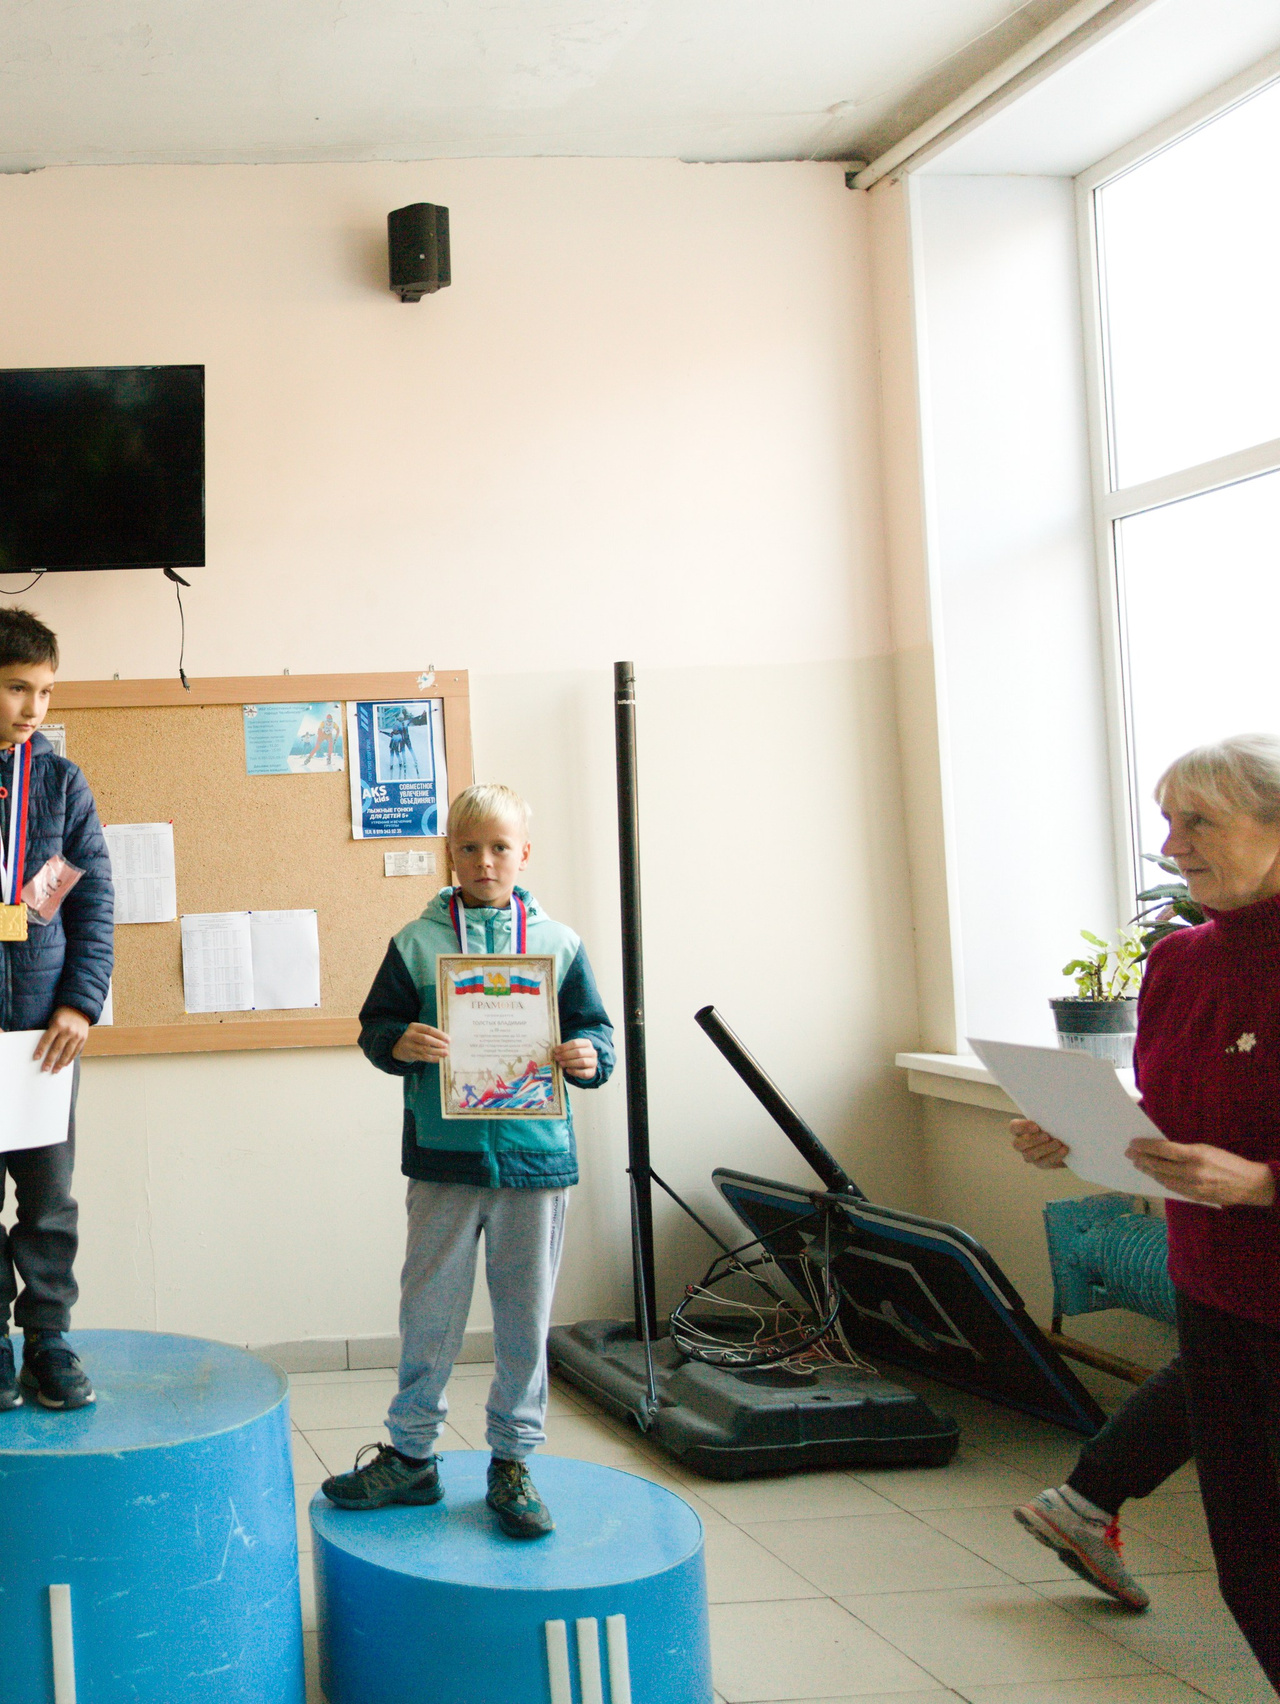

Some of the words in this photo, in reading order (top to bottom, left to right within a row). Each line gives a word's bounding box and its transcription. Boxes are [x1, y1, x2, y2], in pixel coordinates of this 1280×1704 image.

[363, 785, 387, 799] AKS
[374, 795, 390, 804] kids
[471, 1000, 524, 1010] ГРАМОТА
